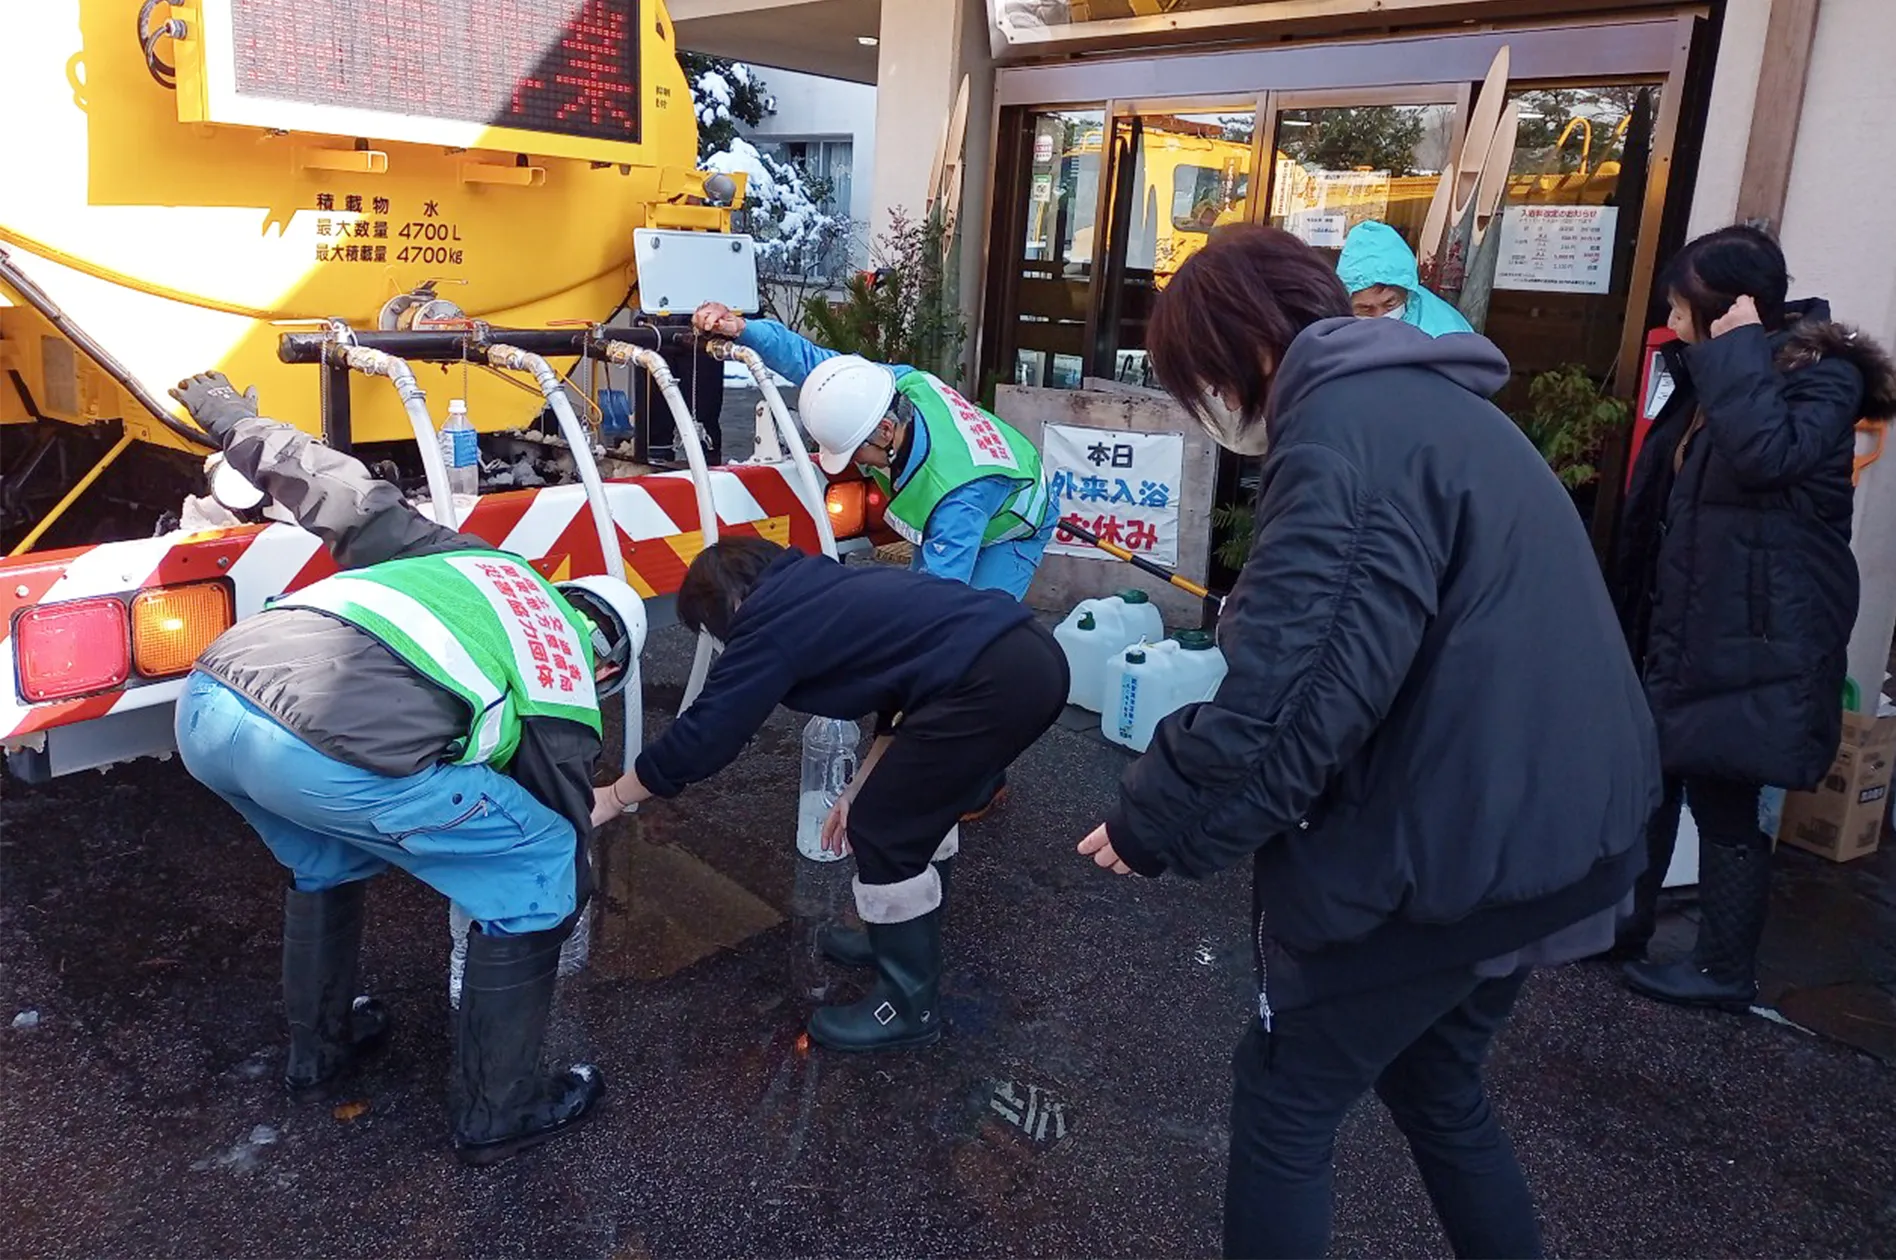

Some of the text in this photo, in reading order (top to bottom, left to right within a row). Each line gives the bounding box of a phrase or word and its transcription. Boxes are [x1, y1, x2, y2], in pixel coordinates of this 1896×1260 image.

[316, 193, 439, 218] 積載物 水
[316, 218, 389, 239] 最大数量
[315, 243, 387, 263] 最大積載量
[1087, 442, 1134, 469] 本日
[1051, 470, 1170, 508] 外来入浴
[1056, 512, 1158, 551] お休み
